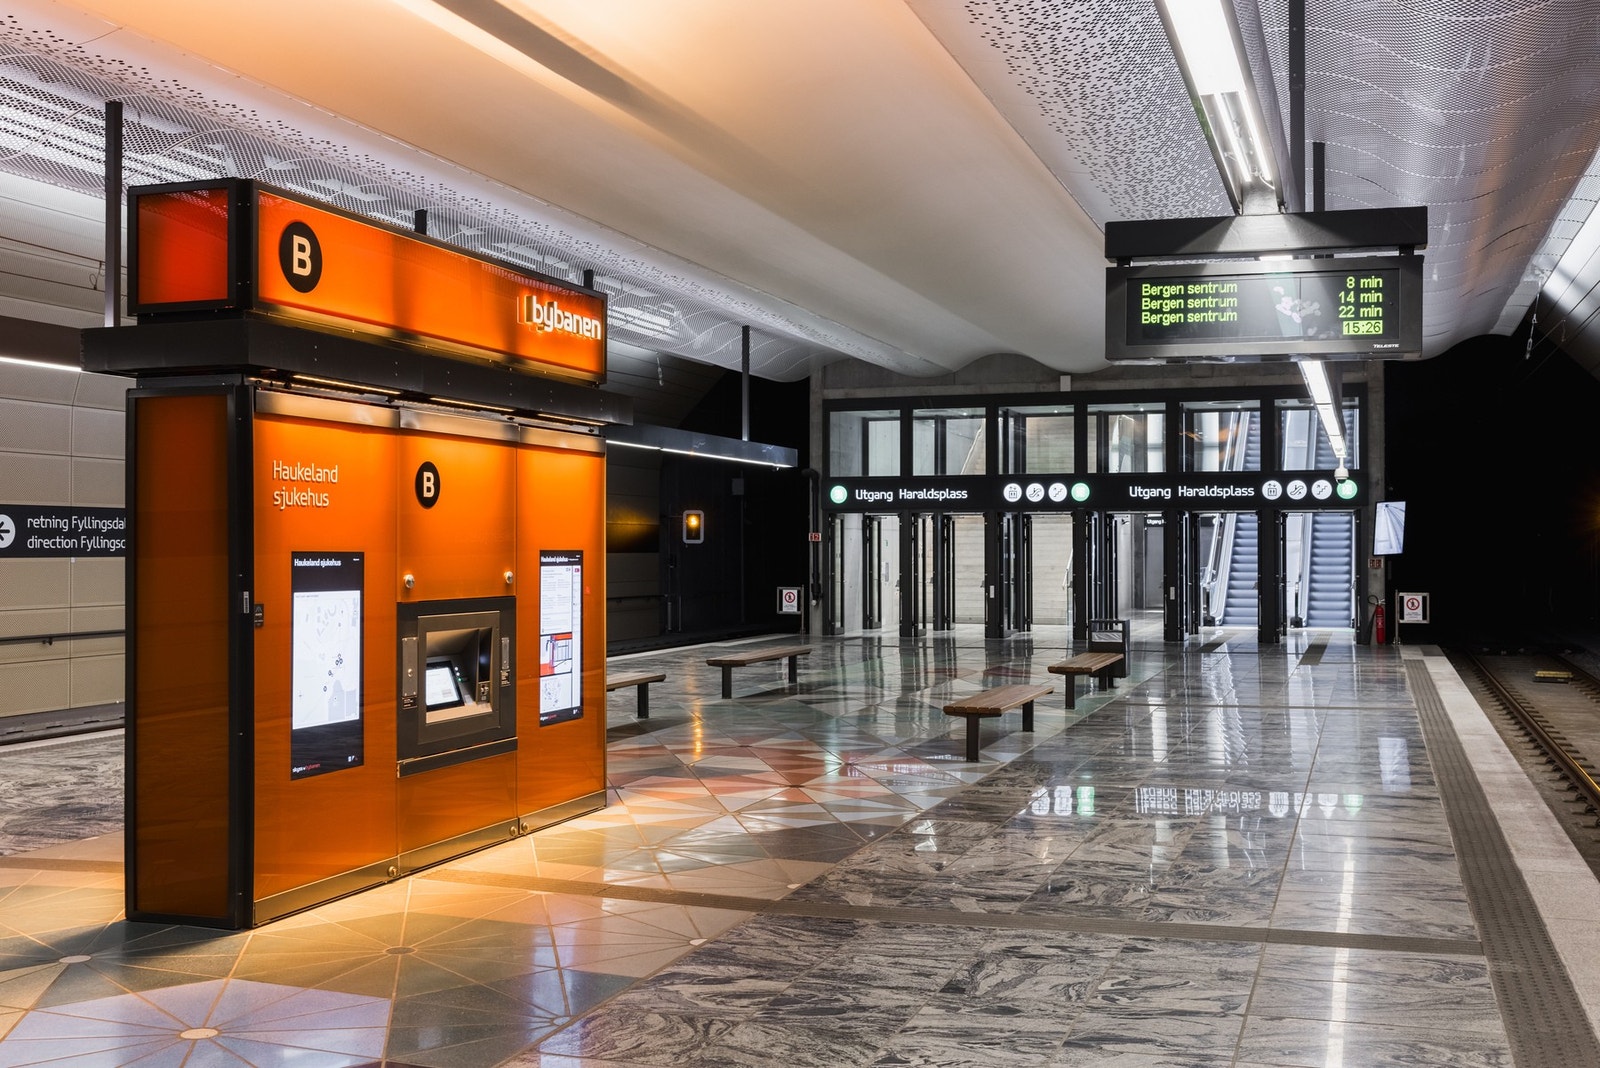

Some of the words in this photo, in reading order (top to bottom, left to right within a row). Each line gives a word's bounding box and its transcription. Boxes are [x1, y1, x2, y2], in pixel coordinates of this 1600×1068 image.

[293, 234, 312, 276] B
[1142, 283, 1184, 298] Bergen
[1187, 282, 1238, 295] sentrum
[1346, 276, 1356, 289] 8
[1360, 275, 1383, 288] min
[1142, 297, 1184, 312] Bergen
[1187, 296, 1238, 309] sentrum
[1338, 291, 1355, 303] 14
[1360, 290, 1383, 303] min
[531, 295, 602, 340] bybanen
[1142, 311, 1184, 326] Bergen
[1187, 310, 1238, 323] sentrum
[1338, 305, 1355, 318] 22
[1360, 304, 1383, 317] min
[1344, 321, 1381, 334] 15:26
[273, 460, 338, 483] Haukeland
[423, 471, 435, 498] B
[855, 489, 893, 502] Utgang
[899, 488, 968, 501] Haraldsplass
[1129, 486, 1171, 500] Utgang
[1178, 485, 1255, 499] Haraldsplass
[273, 486, 329, 510] sjukehus
[27, 515, 69, 531] retning
[27, 535, 78, 549] direction
